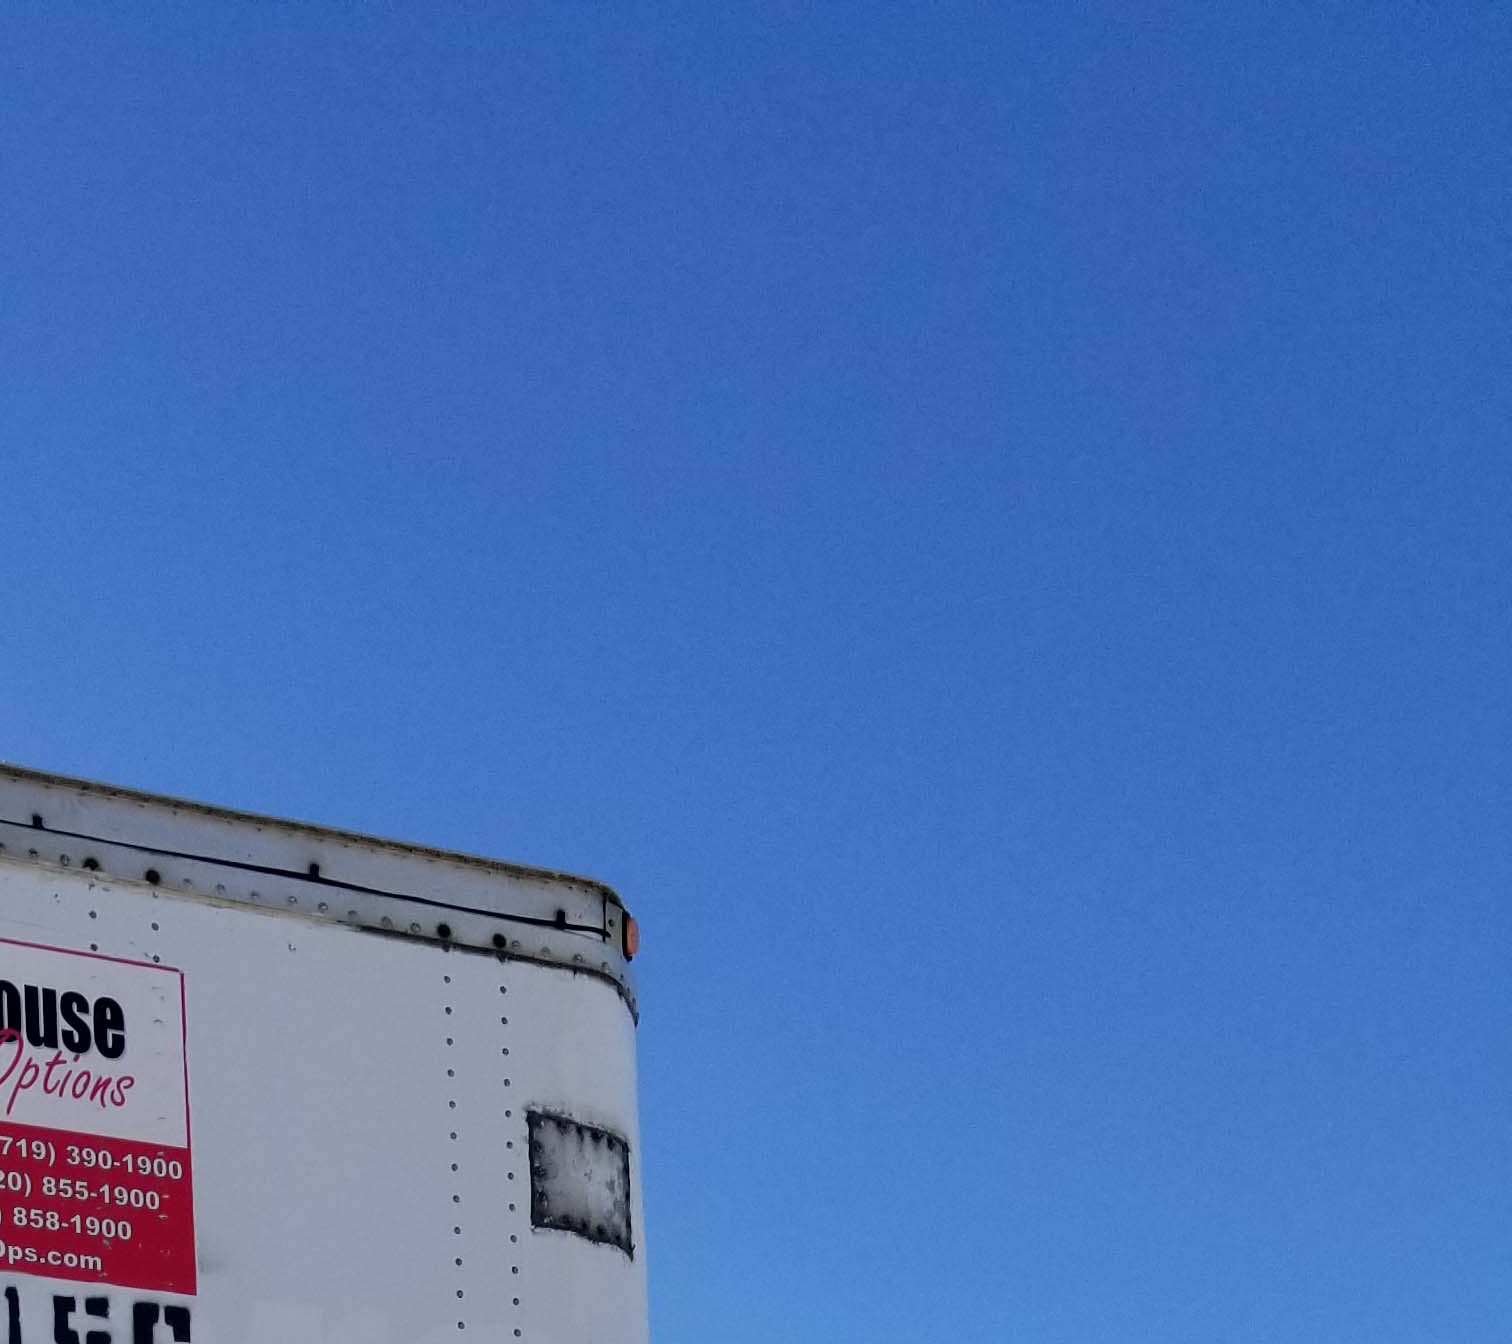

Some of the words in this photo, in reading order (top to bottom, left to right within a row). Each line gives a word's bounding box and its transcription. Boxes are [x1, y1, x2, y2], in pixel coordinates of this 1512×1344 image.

[66, 1145, 183, 1181] 390-1900
[42, 1176, 160, 1211] 855-1900
[13, 1208, 132, 1241] 858-1900
